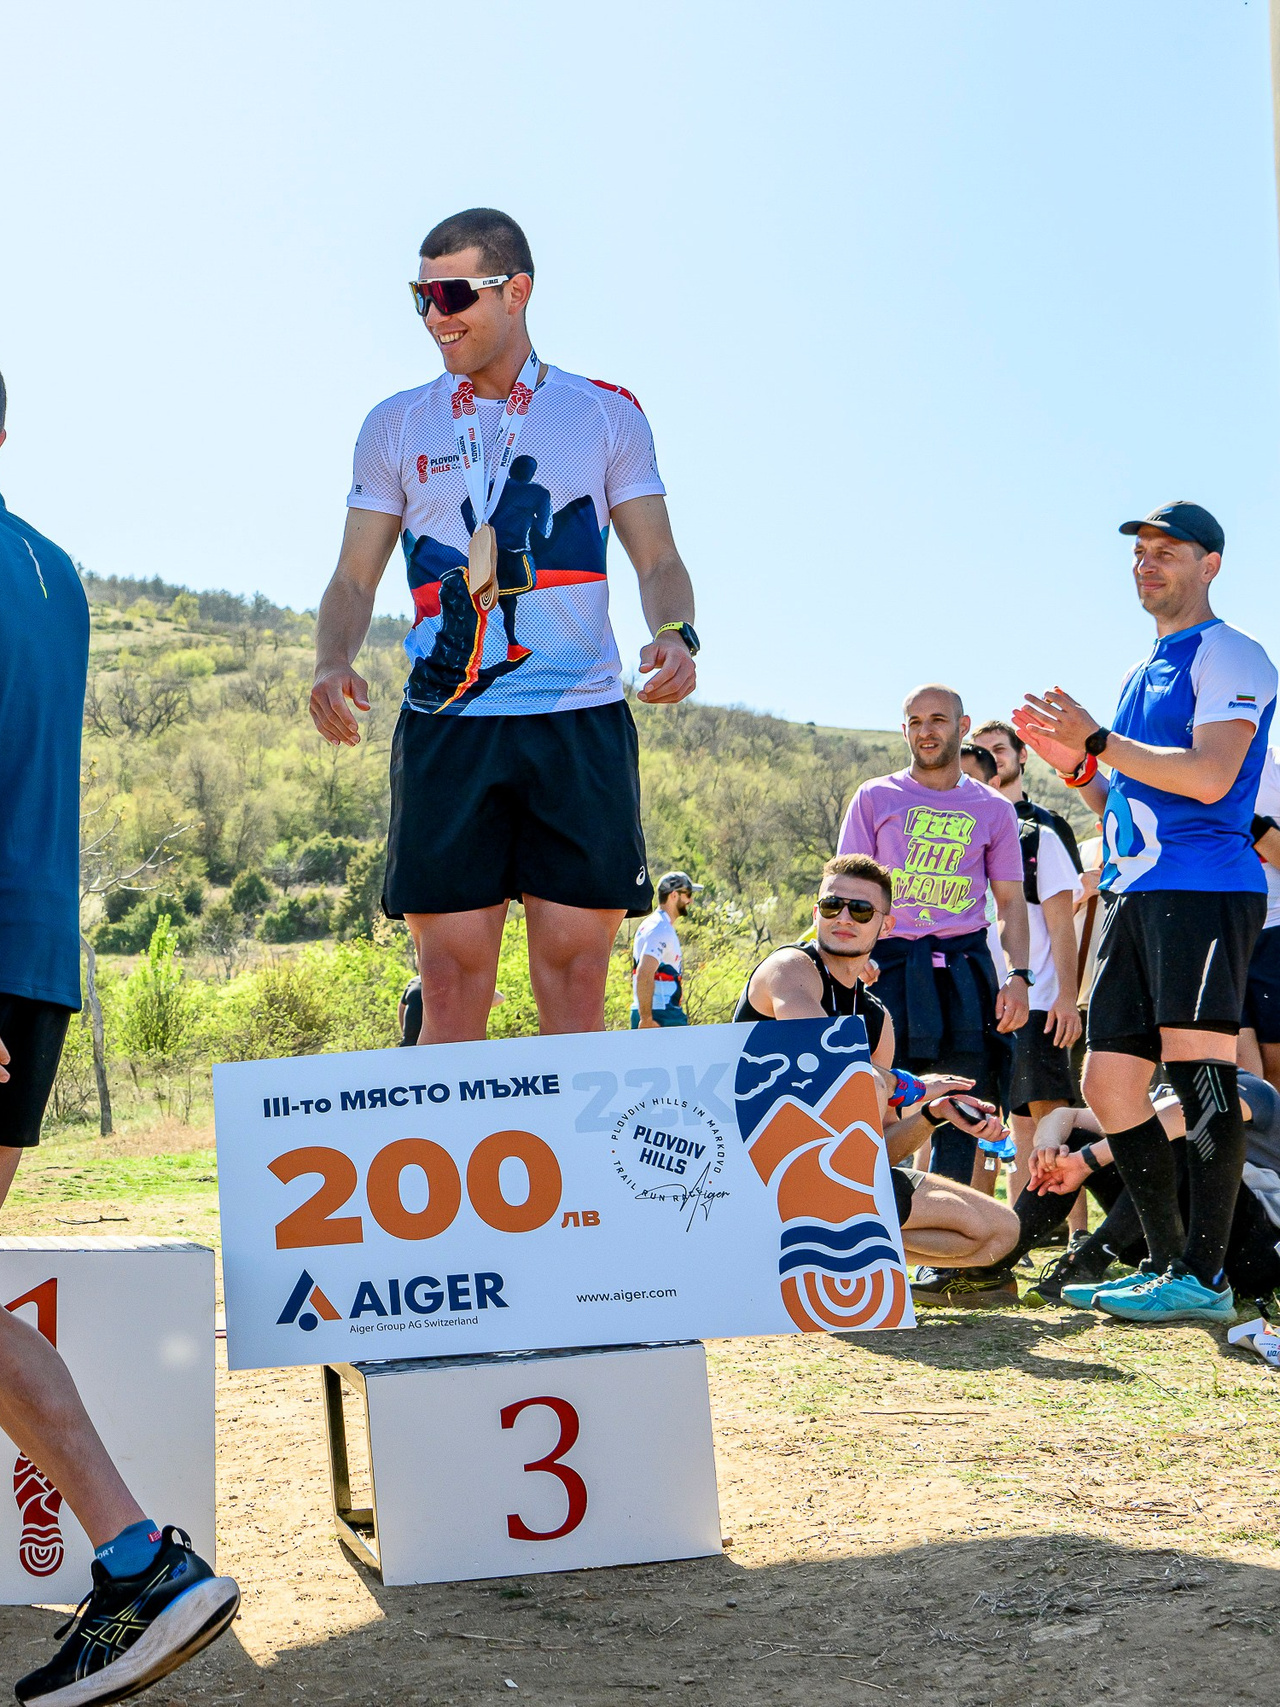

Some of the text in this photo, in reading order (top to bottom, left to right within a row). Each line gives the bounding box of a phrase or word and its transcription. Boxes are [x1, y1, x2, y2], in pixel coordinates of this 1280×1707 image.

[431, 463, 451, 475] HILLS
[905, 836, 965, 875] THE
[340, 1083, 451, 1111] МЯСТО
[459, 1074, 561, 1101] МЪЖЕ
[571, 1062, 736, 1134] 22K
[611, 1097, 725, 1174] PLOVDIV HILLS IN MARKOVO
[632, 1124, 707, 1160] PLOVDIV
[638, 1147, 688, 1175] HILLS
[265, 1129, 563, 1250] 200
[613, 1160, 637, 1191] TRAIL
[641, 1189, 666, 1202] RUN
[348, 1271, 510, 1319] AIGER
[576, 1286, 677, 1303] www.aiger.com
[349, 1315, 479, 1334] Aiger Group AG Switzerland
[497, 1396, 589, 1542] 3
